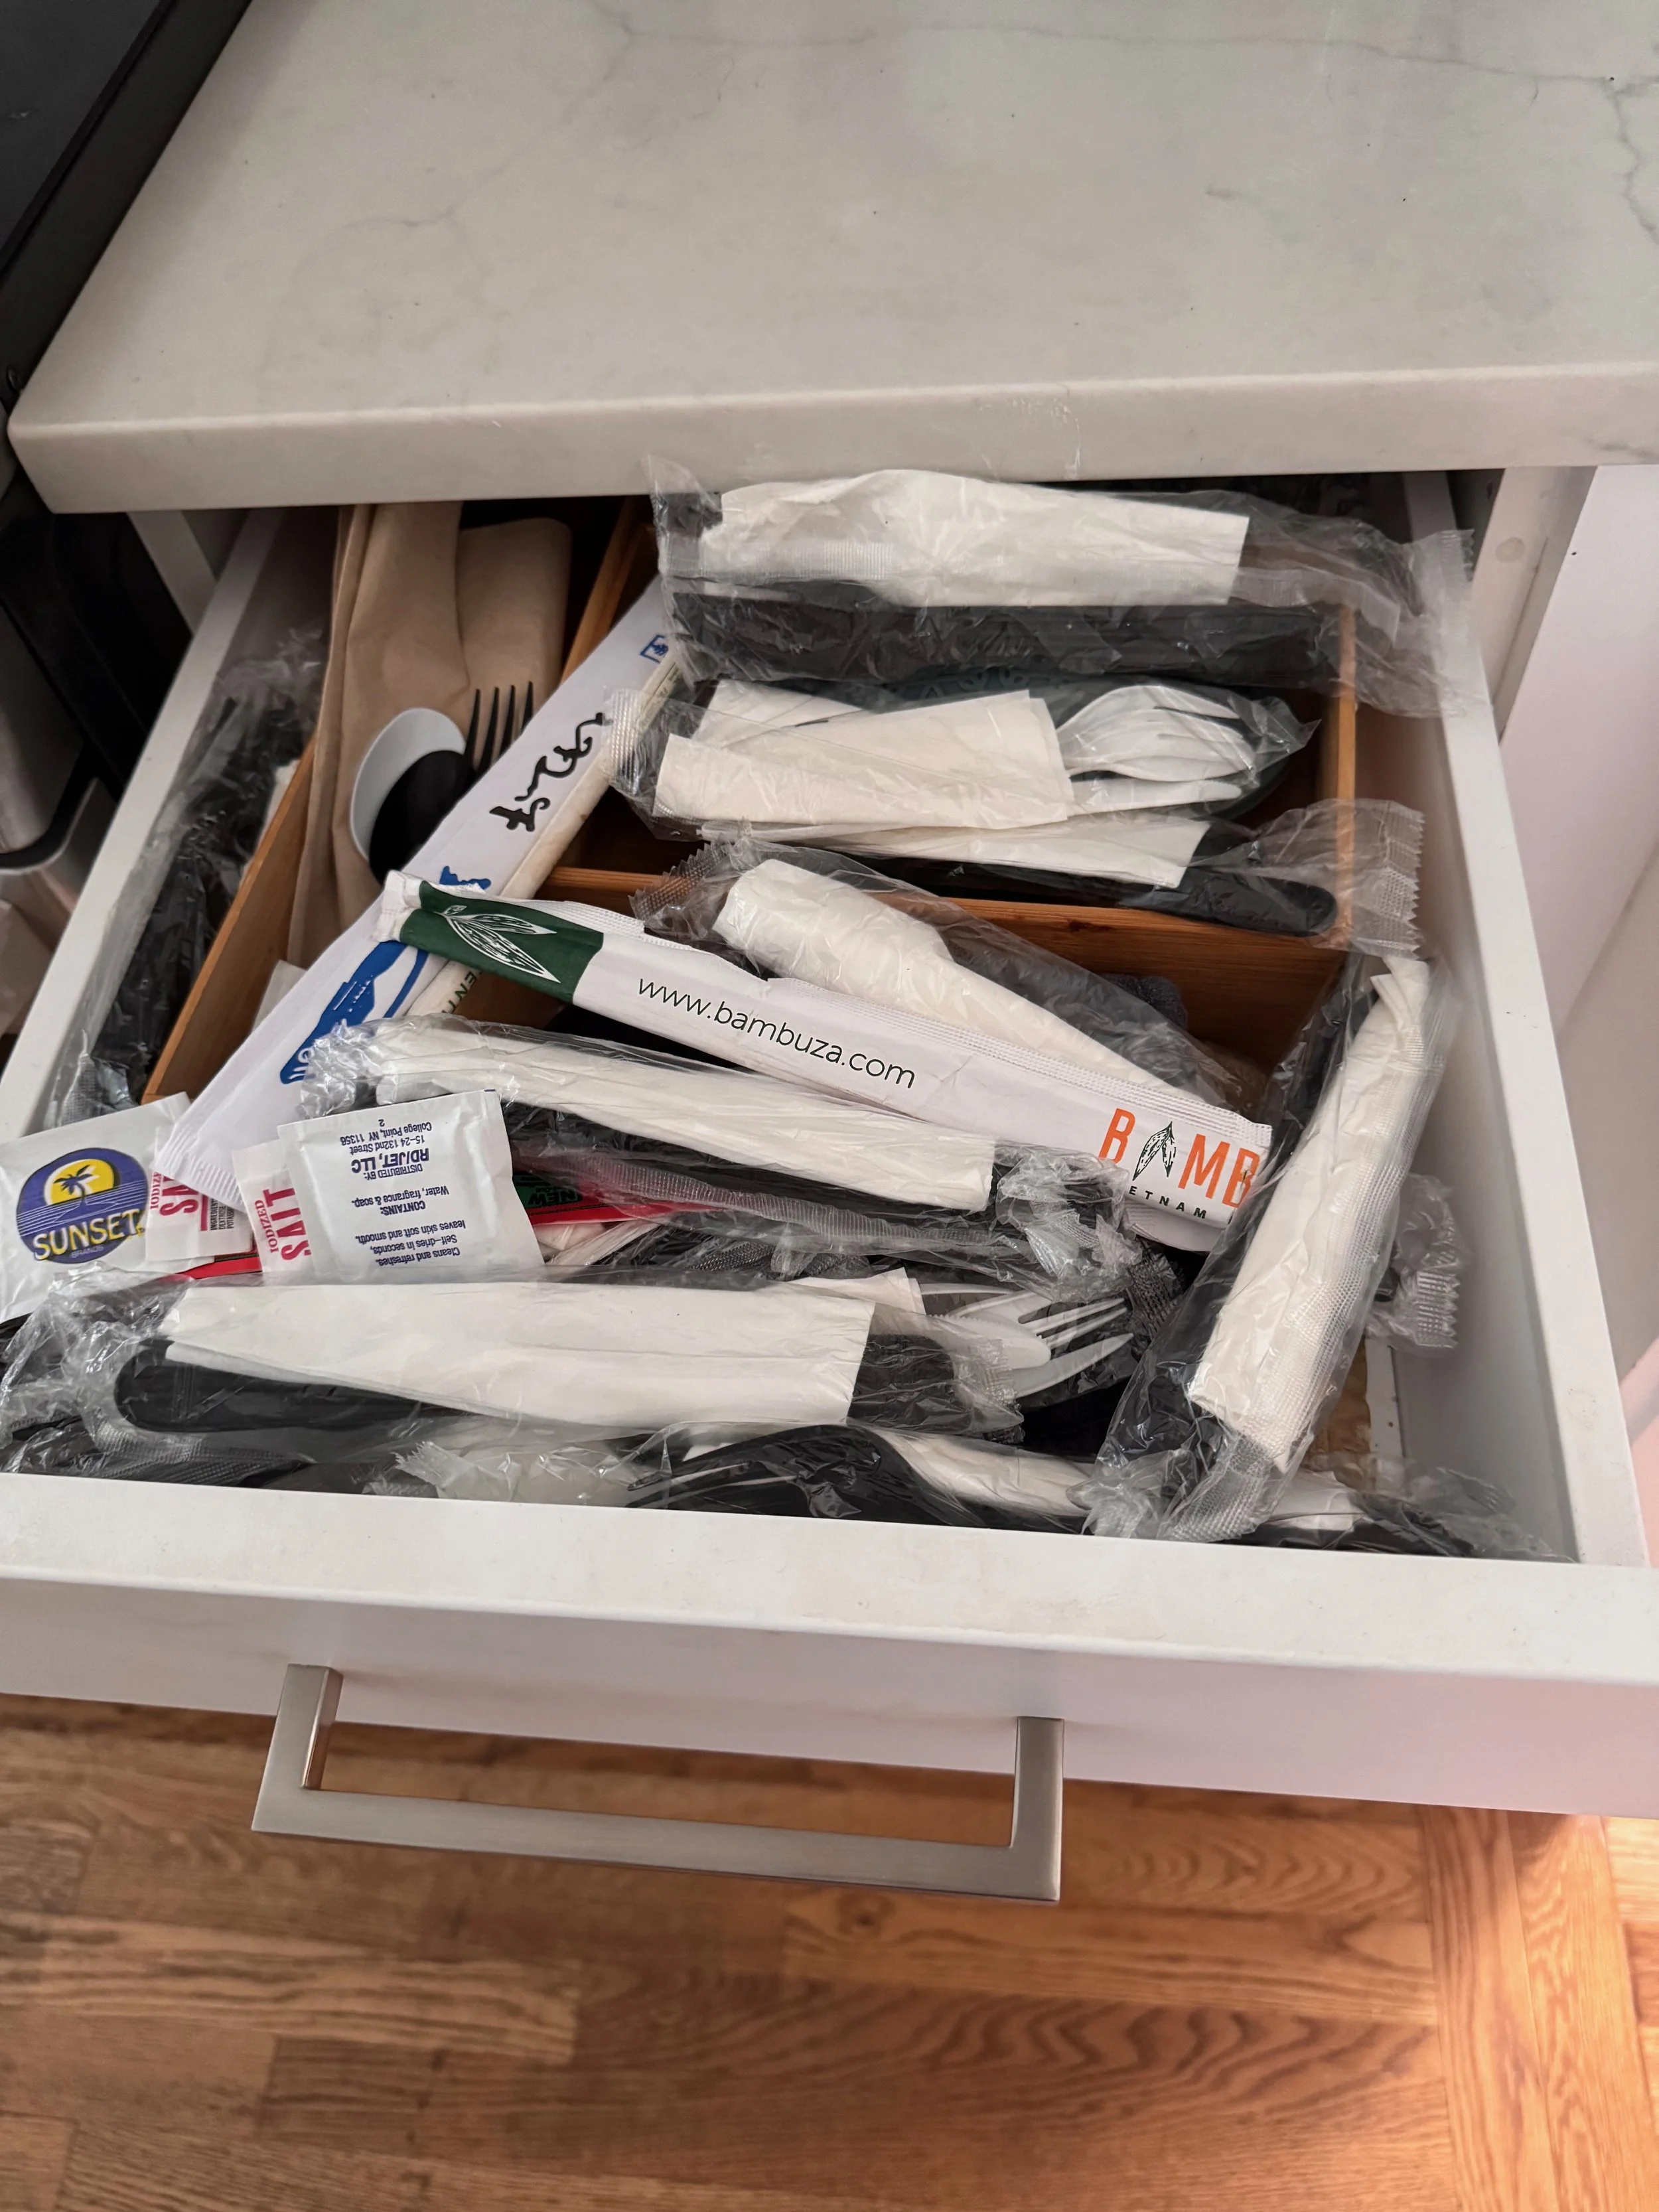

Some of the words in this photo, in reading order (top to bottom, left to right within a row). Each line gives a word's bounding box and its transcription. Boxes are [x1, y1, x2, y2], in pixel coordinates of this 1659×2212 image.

[638, 978, 916, 1089] www.bambuza.com
[380, 1128, 403, 1138] Point,
[404, 1122, 433, 1133] College
[369, 1131, 380, 1142] NY
[350, 1143, 374, 1155] Street
[376, 1140, 398, 1151] 132nd
[379, 1147, 429, 1168] RD/JET,
[351, 1157, 376, 1173] LLC
[378, 1163, 423, 1178] DISTRIBUTED
[364, 1171, 376, 1181] BY:
[383, 1189, 421, 1203] fragrance
[422, 1185, 450, 1196] Water,
[352, 1197, 374, 1208] soap.
[380, 1200, 426, 1216] CONTAINS:
[255, 1199, 279, 1253] IODIZED
[421, 1224, 438, 1234] skin
[439, 1220, 466, 1230] leaves
[33, 1208, 141, 1261] SUNSET
[355, 1232, 387, 1244] smooth.
[388, 1230, 403, 1240] and
[403, 1228, 419, 1238] soft
[370, 1242, 405, 1255] seconds,
[406, 1241, 415, 1250] in
[416, 1250, 431, 1260] and
[433, 1247, 461, 1258] Cleans
[376, 1254, 415, 1266] refreshes.
